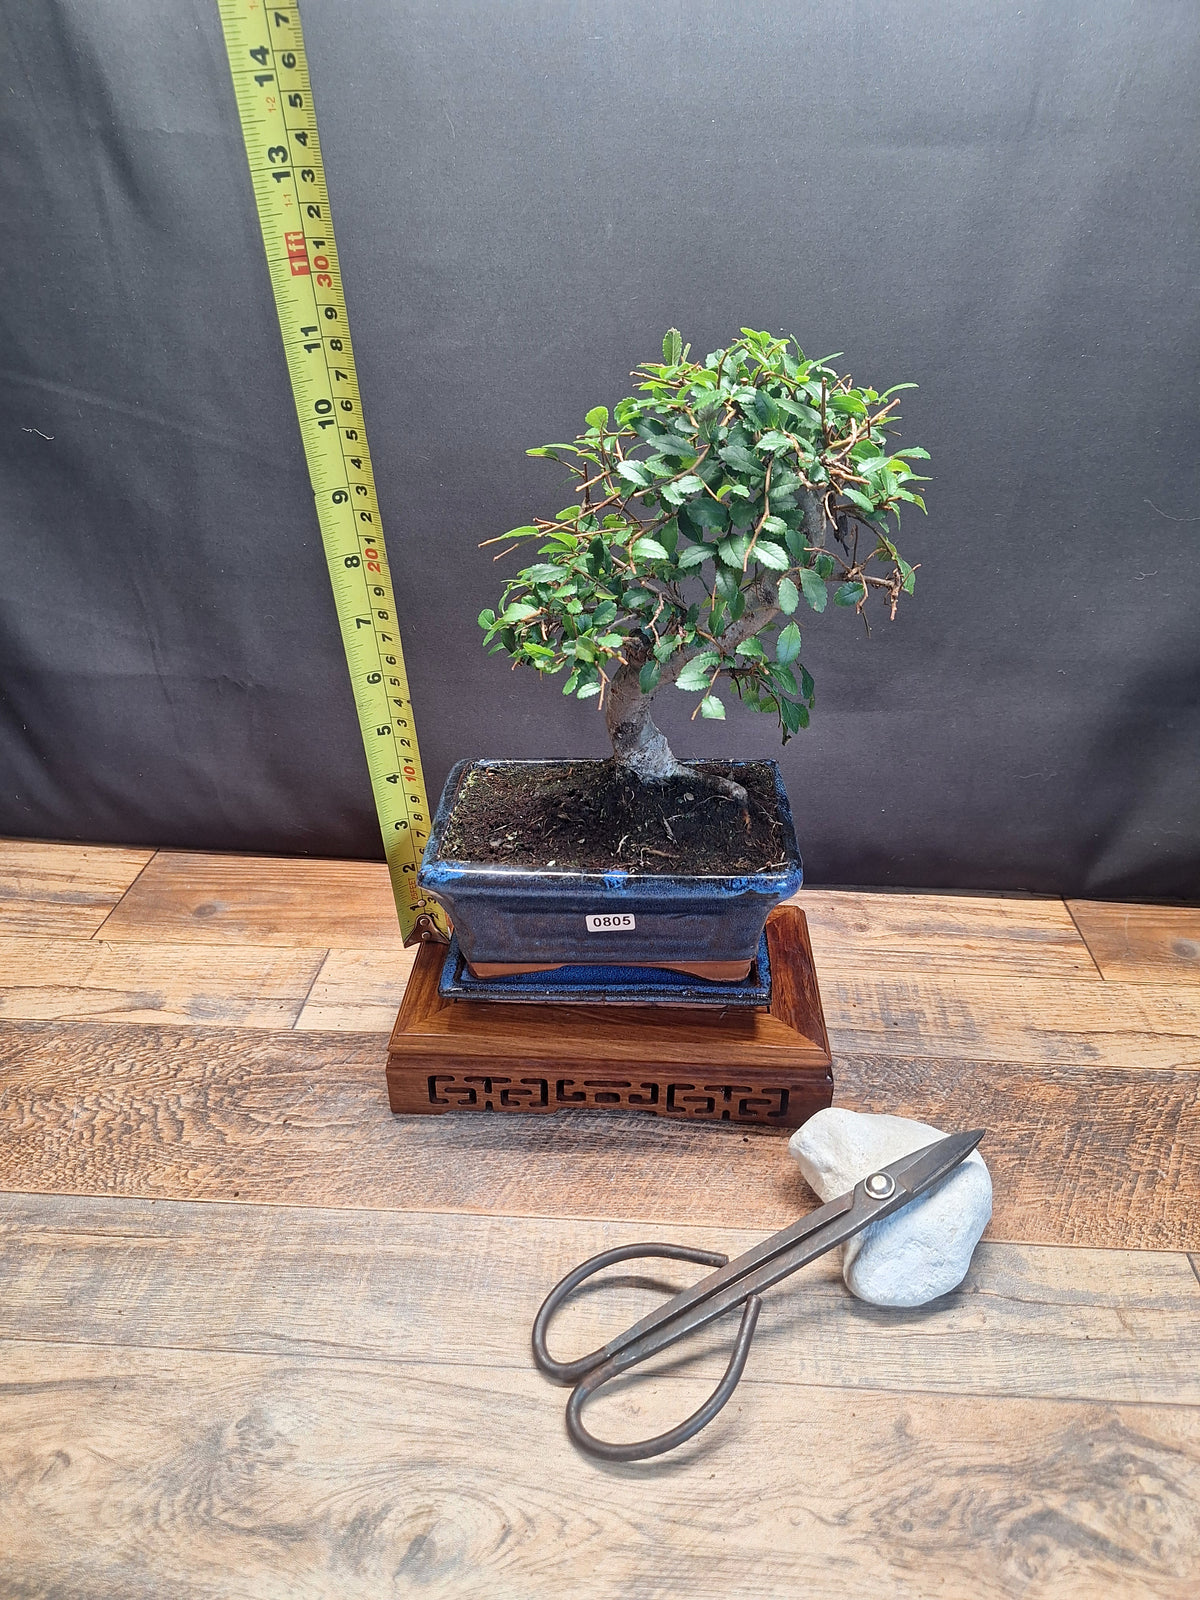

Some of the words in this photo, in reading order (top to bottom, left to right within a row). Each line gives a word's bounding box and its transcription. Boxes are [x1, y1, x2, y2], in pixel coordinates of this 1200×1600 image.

[274, 12, 289, 27] 7
[249, 45, 274, 87] 14
[282, 52, 296, 69] 6
[266, 97, 276, 113] 1-2
[288, 93, 303, 108] 5
[295, 131, 308, 146] 4
[268, 145, 291, 183] 13
[301, 169, 315, 183] 3
[307, 205, 321, 218] 2
[313, 241, 325, 249] 1
[313, 255, 332, 288] 30
[325, 307, 337, 320] 9
[300, 326, 321, 353] 11
[330, 339, 343, 351] 8
[335, 370, 348, 381] 7
[341, 400, 352, 411] 6
[314, 399, 334, 429] 10
[345, 430, 358, 441] 5
[351, 458, 362, 469] 4
[355, 485, 367, 496] 3
[332, 490, 348, 504] 9
[360, 512, 372, 523] 2
[344, 555, 360, 568] 8
[365, 548, 381, 573] 20
[373, 587, 385, 597] 9
[377, 611, 389, 620] 8
[356, 618, 371, 629] 7
[382, 634, 392, 642] 7
[385, 656, 396, 665] 6
[367, 672, 381, 684] 6
[390, 678, 400, 686] 5
[393, 699, 403, 707] 4
[397, 719, 407, 727] 3
[377, 725, 391, 736] 5
[400, 739, 411, 747] 2
[386, 774, 399, 784] 4
[404, 766, 417, 782] 10
[410, 795, 420, 803] 9
[413, 813, 423, 821] 8
[394, 821, 408, 831] 3
[403, 863, 416, 873] 2
[593, 916, 631, 927] 0805
